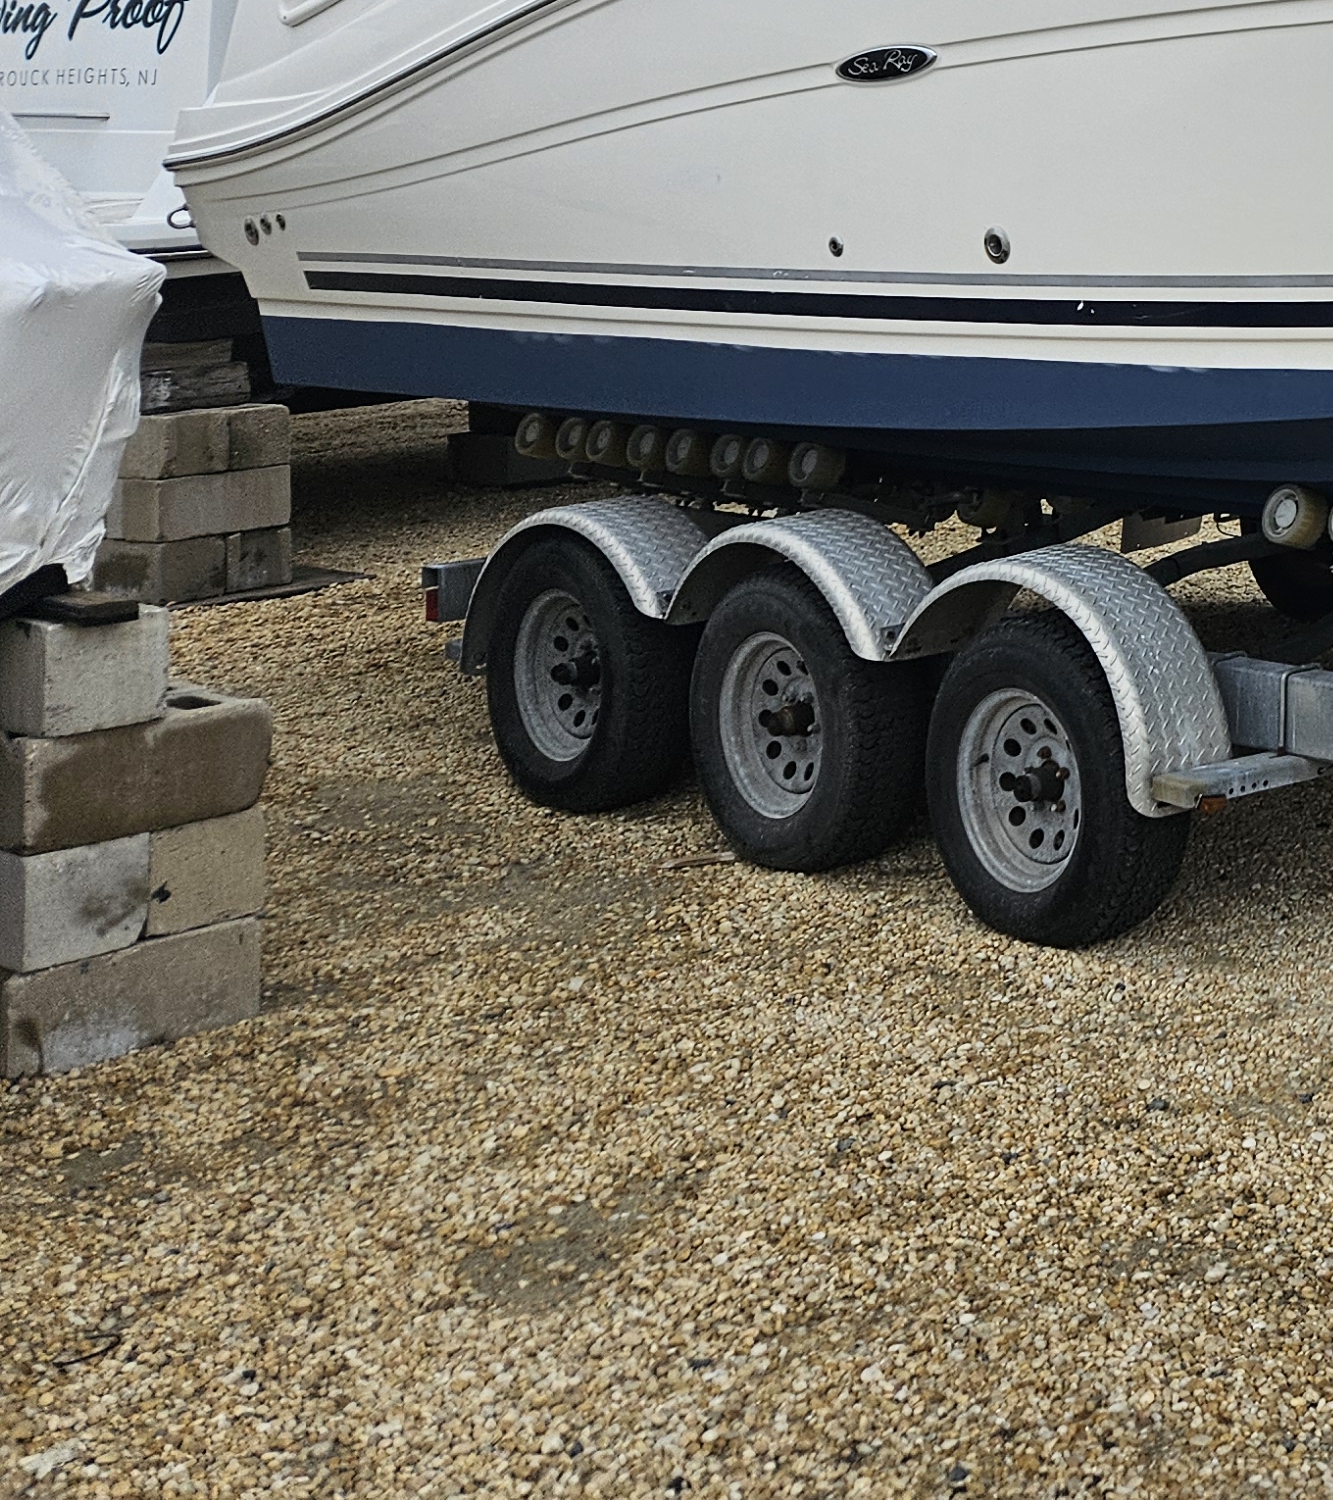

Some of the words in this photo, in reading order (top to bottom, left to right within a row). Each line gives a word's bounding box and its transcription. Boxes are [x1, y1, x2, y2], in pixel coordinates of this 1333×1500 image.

[847, 57, 881, 76] Sea
[882, 49, 918, 73] Ray
[56, 67, 130, 88] HEIGHTS,
[137, 68, 158, 86] NJ
